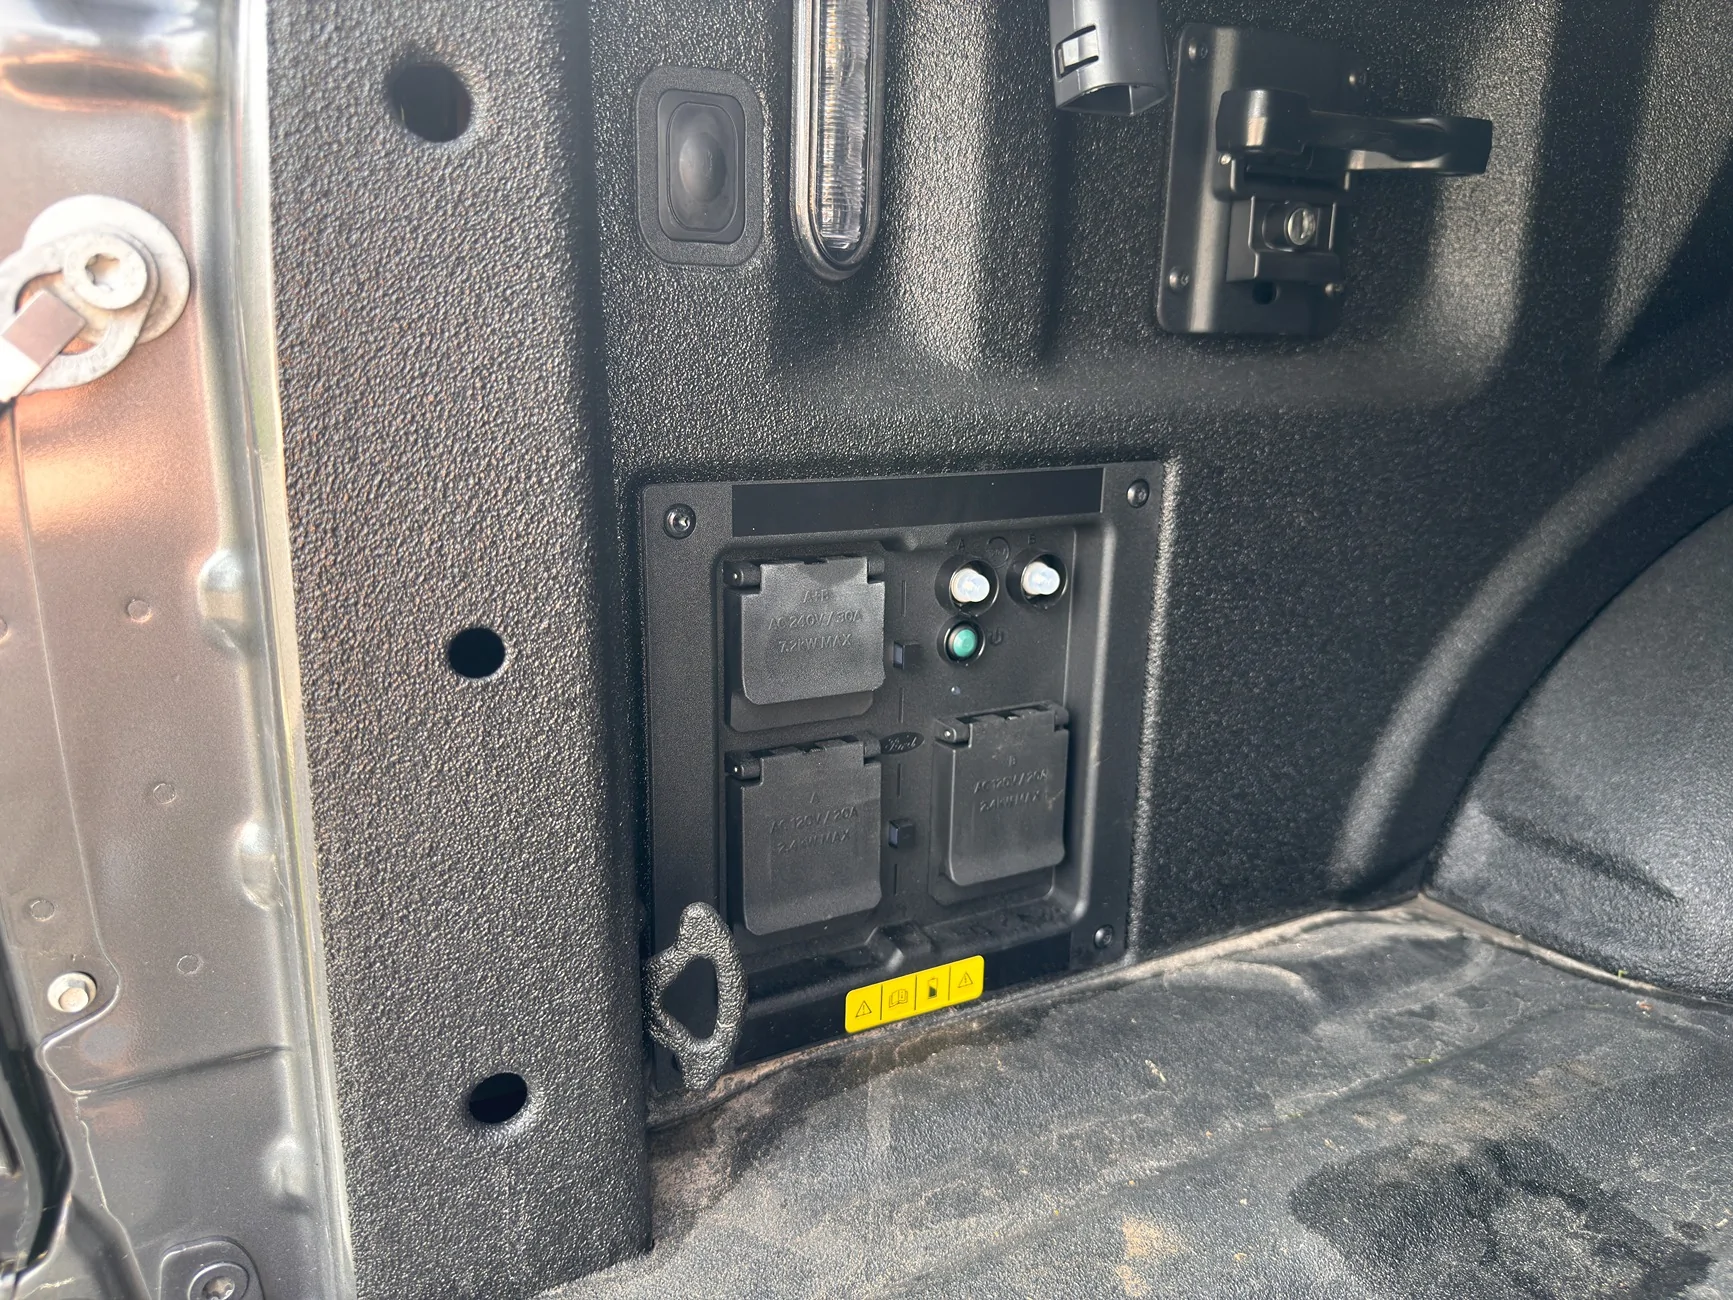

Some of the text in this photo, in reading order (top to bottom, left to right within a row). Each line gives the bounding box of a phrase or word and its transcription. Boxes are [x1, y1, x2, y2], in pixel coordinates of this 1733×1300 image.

[956, 538, 966, 552] A
[803, 588, 831, 604] A+B
[768, 617, 786, 631] AC
[778, 633, 852, 654] 7.2kW MAX
